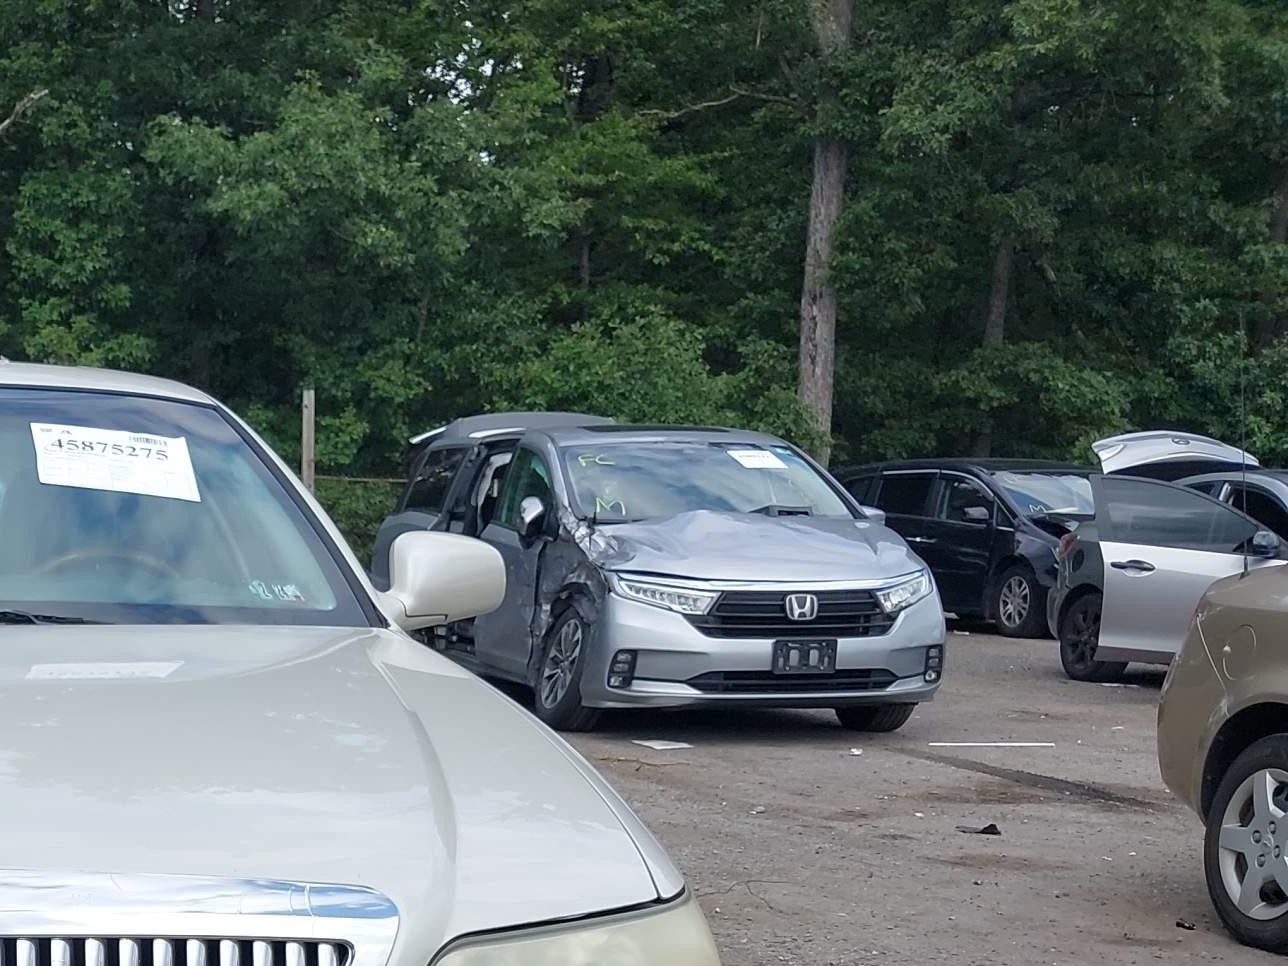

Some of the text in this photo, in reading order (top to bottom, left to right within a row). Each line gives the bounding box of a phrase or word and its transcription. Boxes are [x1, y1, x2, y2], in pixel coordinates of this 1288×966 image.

[50, 437, 169, 462] 45875275
[577, 453, 616, 467] FC
[595, 496, 627, 516] M
[1029, 504, 1048, 513] M
